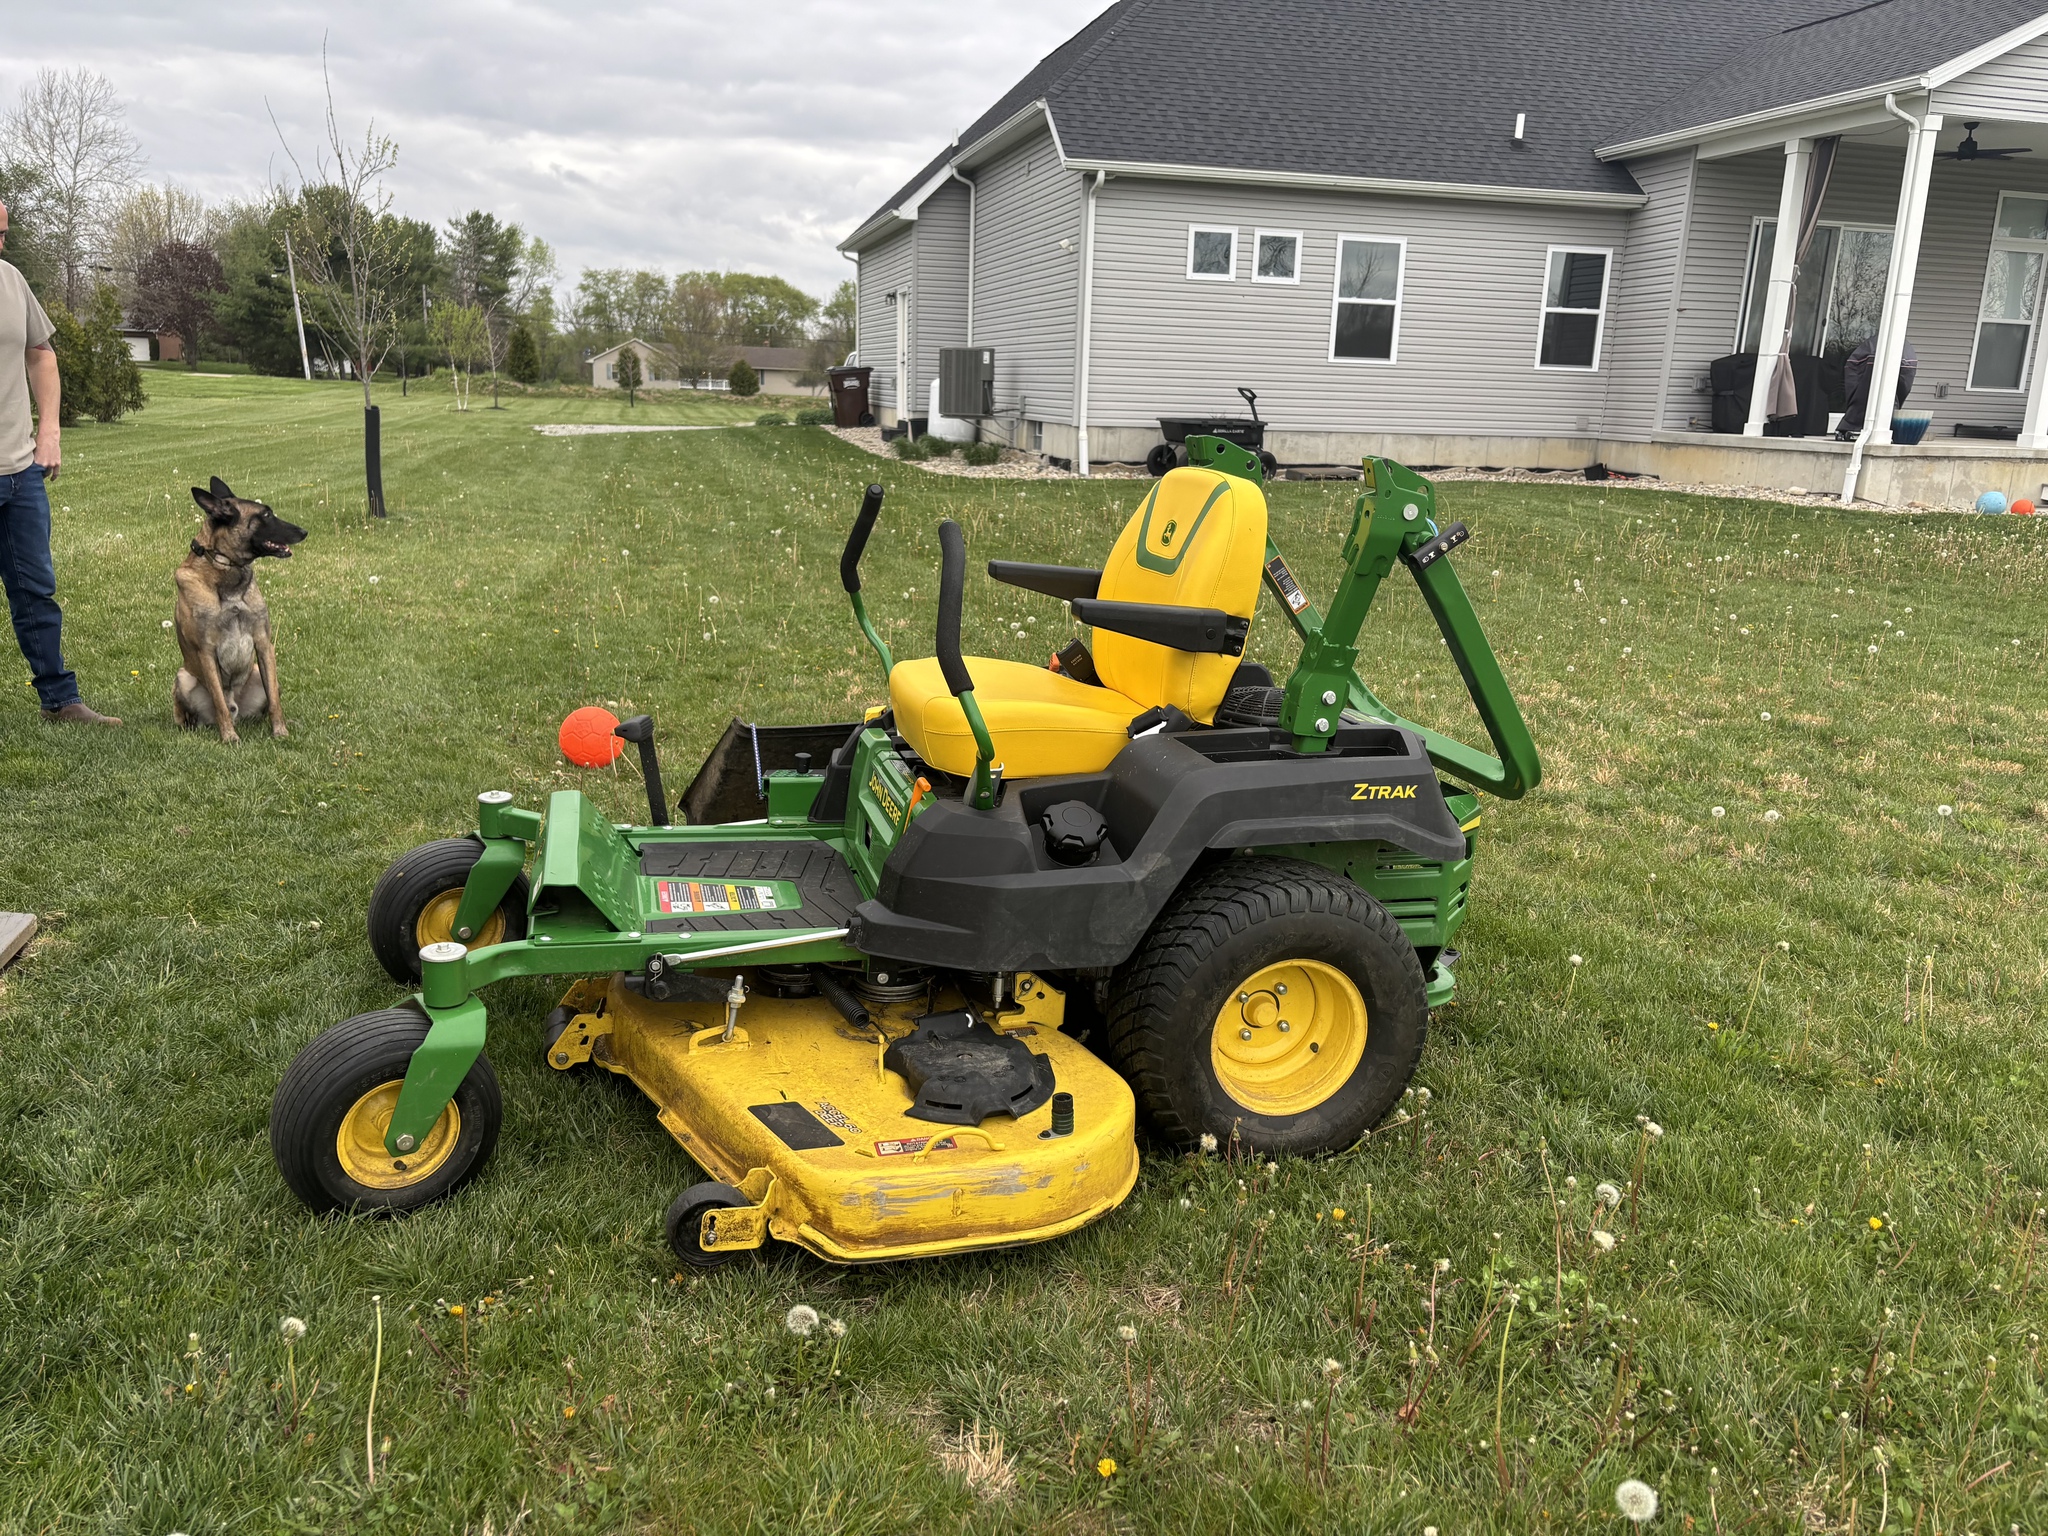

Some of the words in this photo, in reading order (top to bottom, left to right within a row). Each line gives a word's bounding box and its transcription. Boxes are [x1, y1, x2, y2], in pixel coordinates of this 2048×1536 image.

[869, 771, 883, 801] JOHN
[881, 789, 902, 826] DEERE
[1350, 783, 1419, 801] ZTRAK
[813, 1110, 845, 1128] DEEP
[814, 1101, 850, 1124] ACCEL
[844, 1123, 863, 1134] 60
